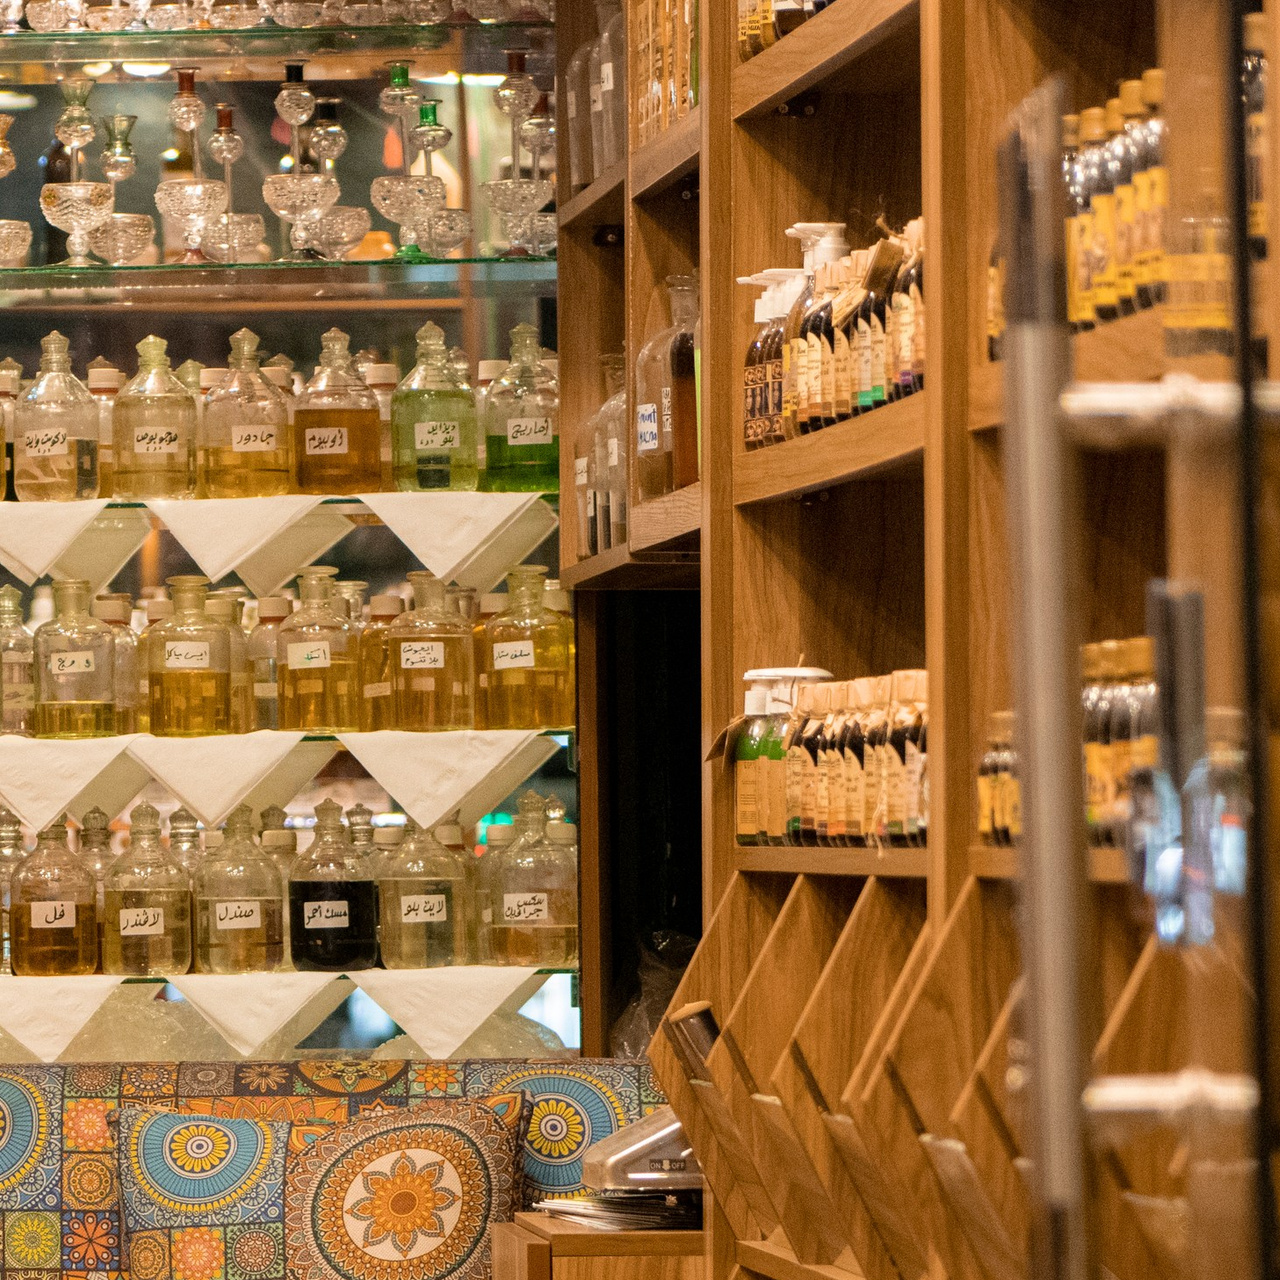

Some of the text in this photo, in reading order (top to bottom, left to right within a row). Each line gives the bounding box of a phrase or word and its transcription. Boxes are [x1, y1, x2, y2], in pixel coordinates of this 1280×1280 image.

[45, 904, 66, 923] فل
[218, 906, 254, 922] صندل
[650, 1162, 661, 1170] ON
